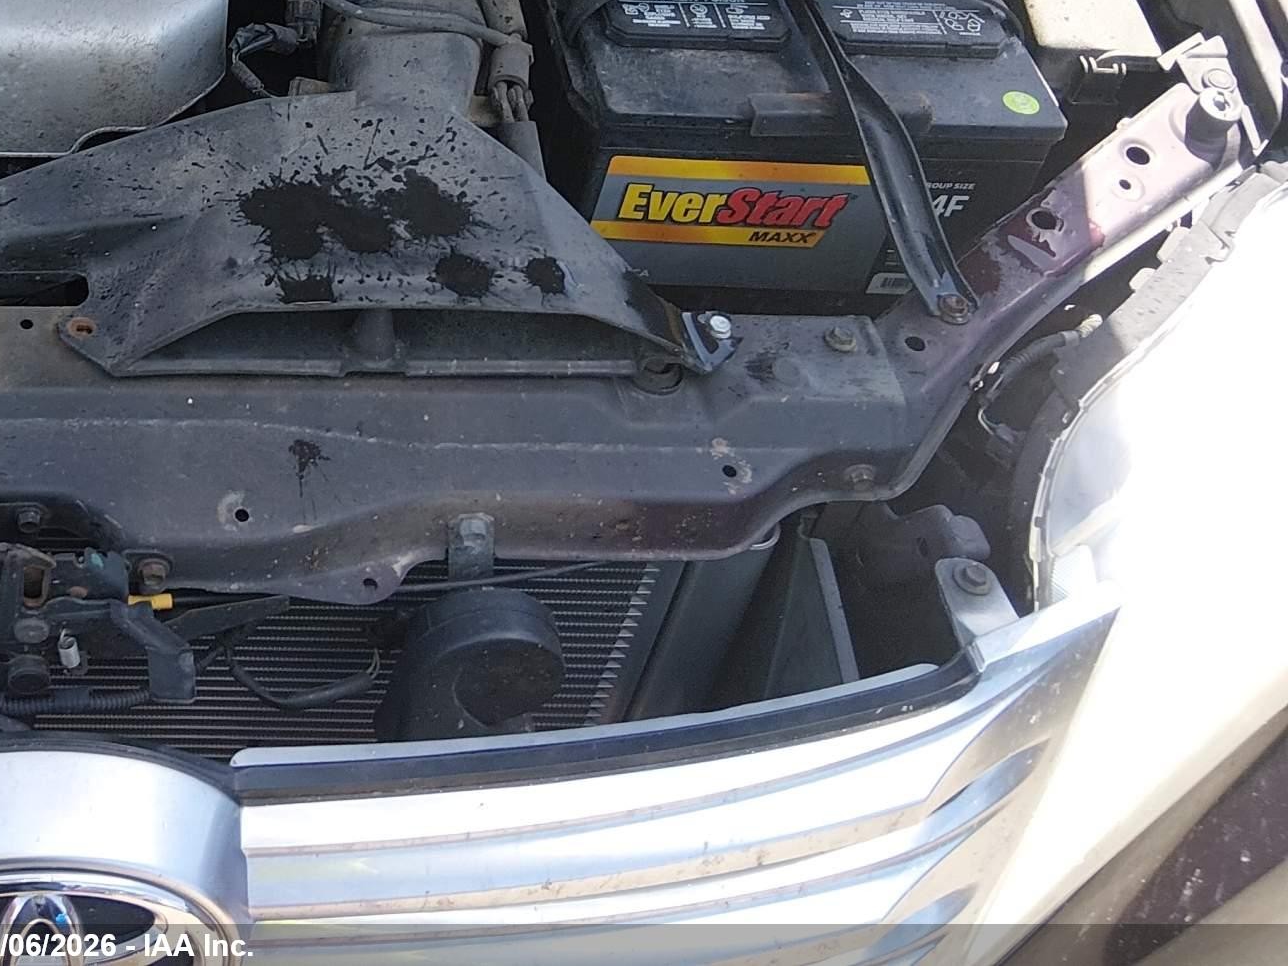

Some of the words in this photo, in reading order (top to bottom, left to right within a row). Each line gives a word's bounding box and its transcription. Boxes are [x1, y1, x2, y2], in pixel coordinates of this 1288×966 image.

[926, 182, 953, 190] ROUP
[953, 182, 976, 190] SIZE
[617, 182, 850, 229] EverStart
[932, 194, 970, 217] 4F
[748, 230, 816, 244] MAXX
